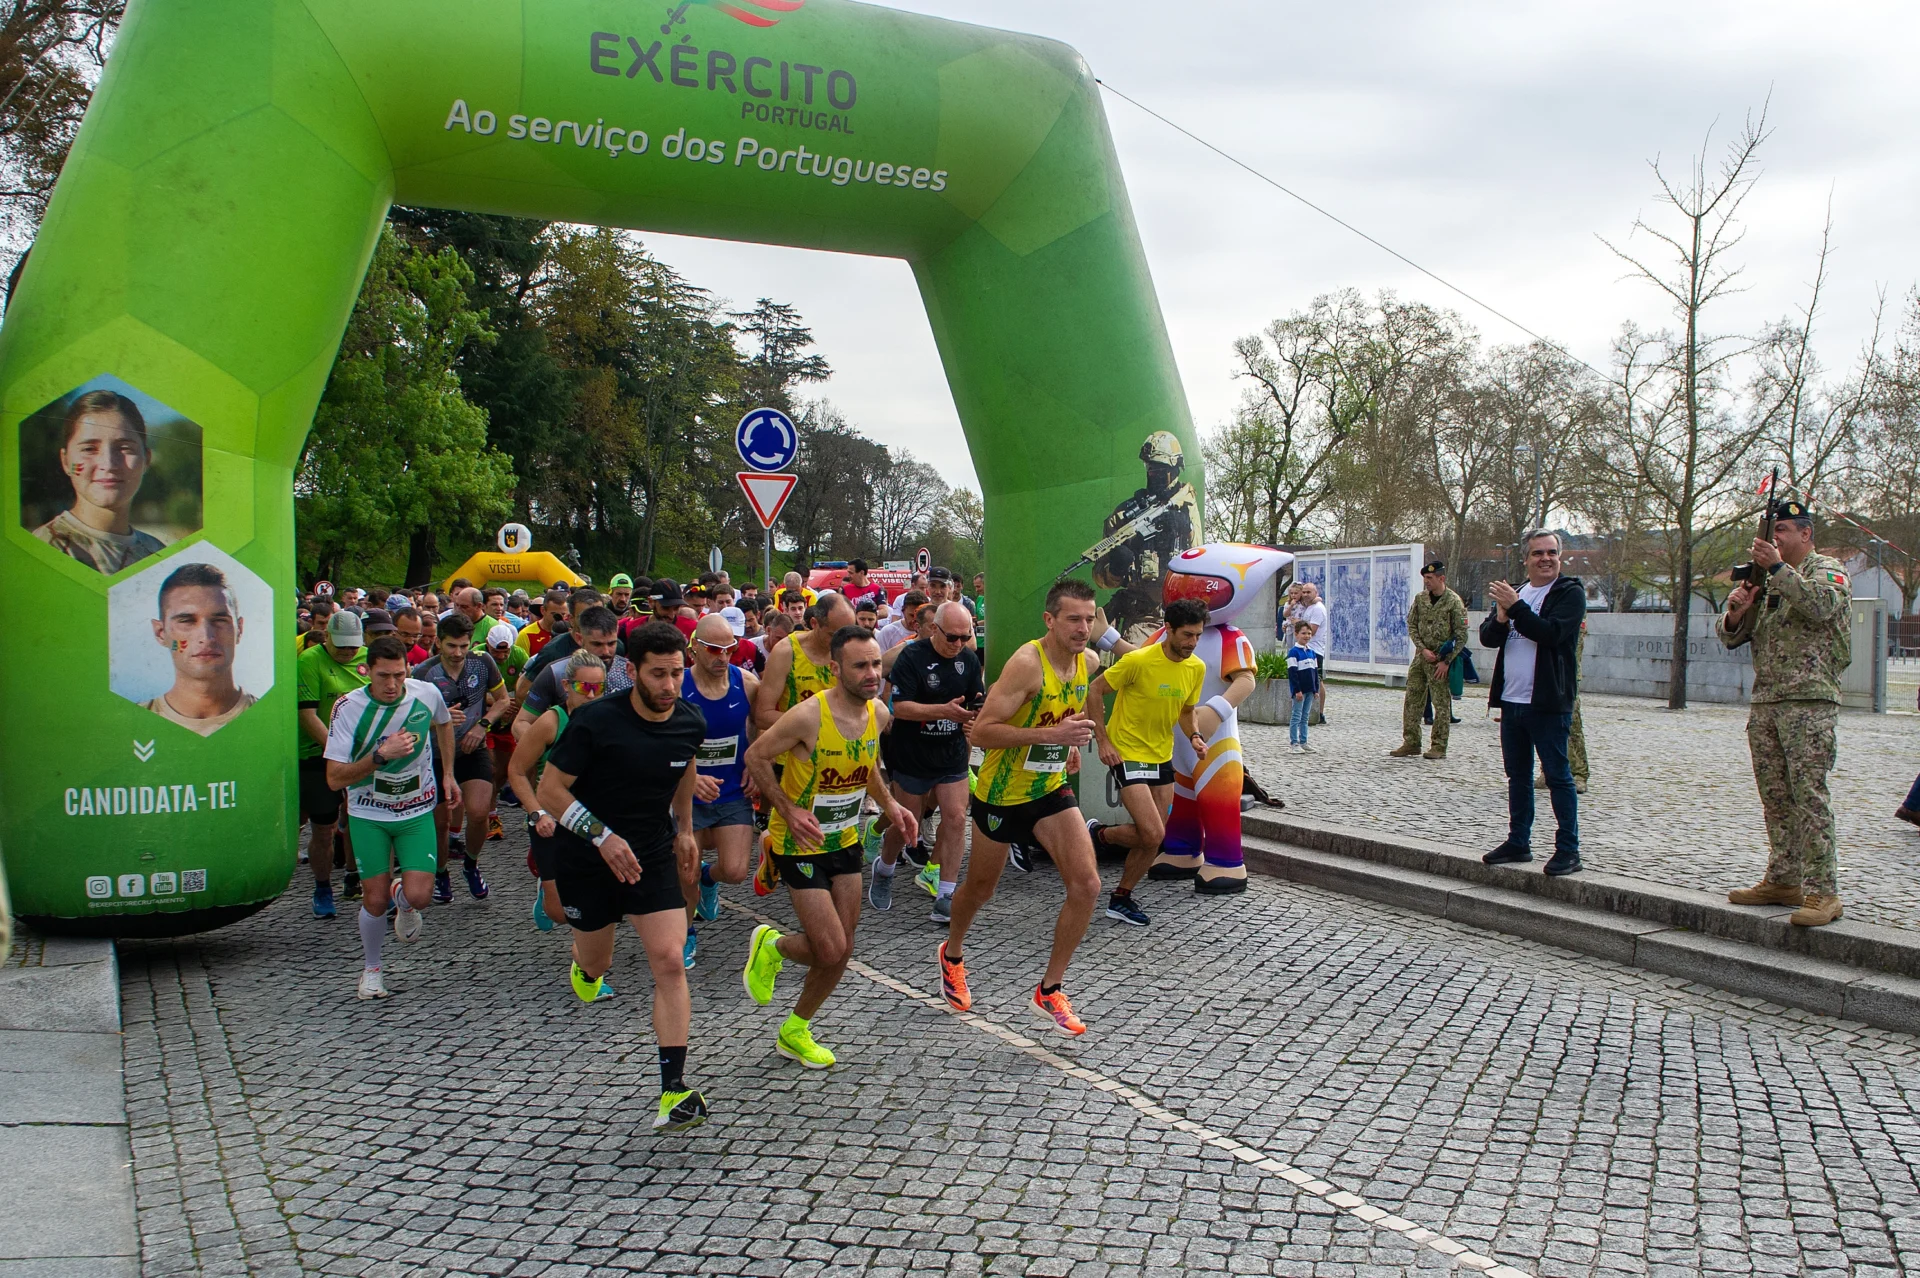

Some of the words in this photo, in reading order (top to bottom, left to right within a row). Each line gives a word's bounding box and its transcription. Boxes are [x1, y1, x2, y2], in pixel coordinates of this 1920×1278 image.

[589, 31, 858, 111] EXÉRCITO
[741, 101, 855, 135] PORTUGAL
[443, 99, 497, 137] Ao
[506, 112, 649, 158] serviço
[661, 127, 726, 166] dos
[734, 138, 949, 192] Portugueses
[488, 564, 521, 574] VISEU
[1206, 580, 1219, 590] 24
[1637, 640, 1673, 654] PORT
[1690, 643, 1707, 655] DE
[1716, 643, 1750, 658] VIRI
[1046, 751, 1060, 760] 245
[64, 781, 236, 816] CANDIDATA-TE!
[833, 811, 847, 820] 246
[158, 874, 169, 882] You
[155, 883, 172, 891] Tube
